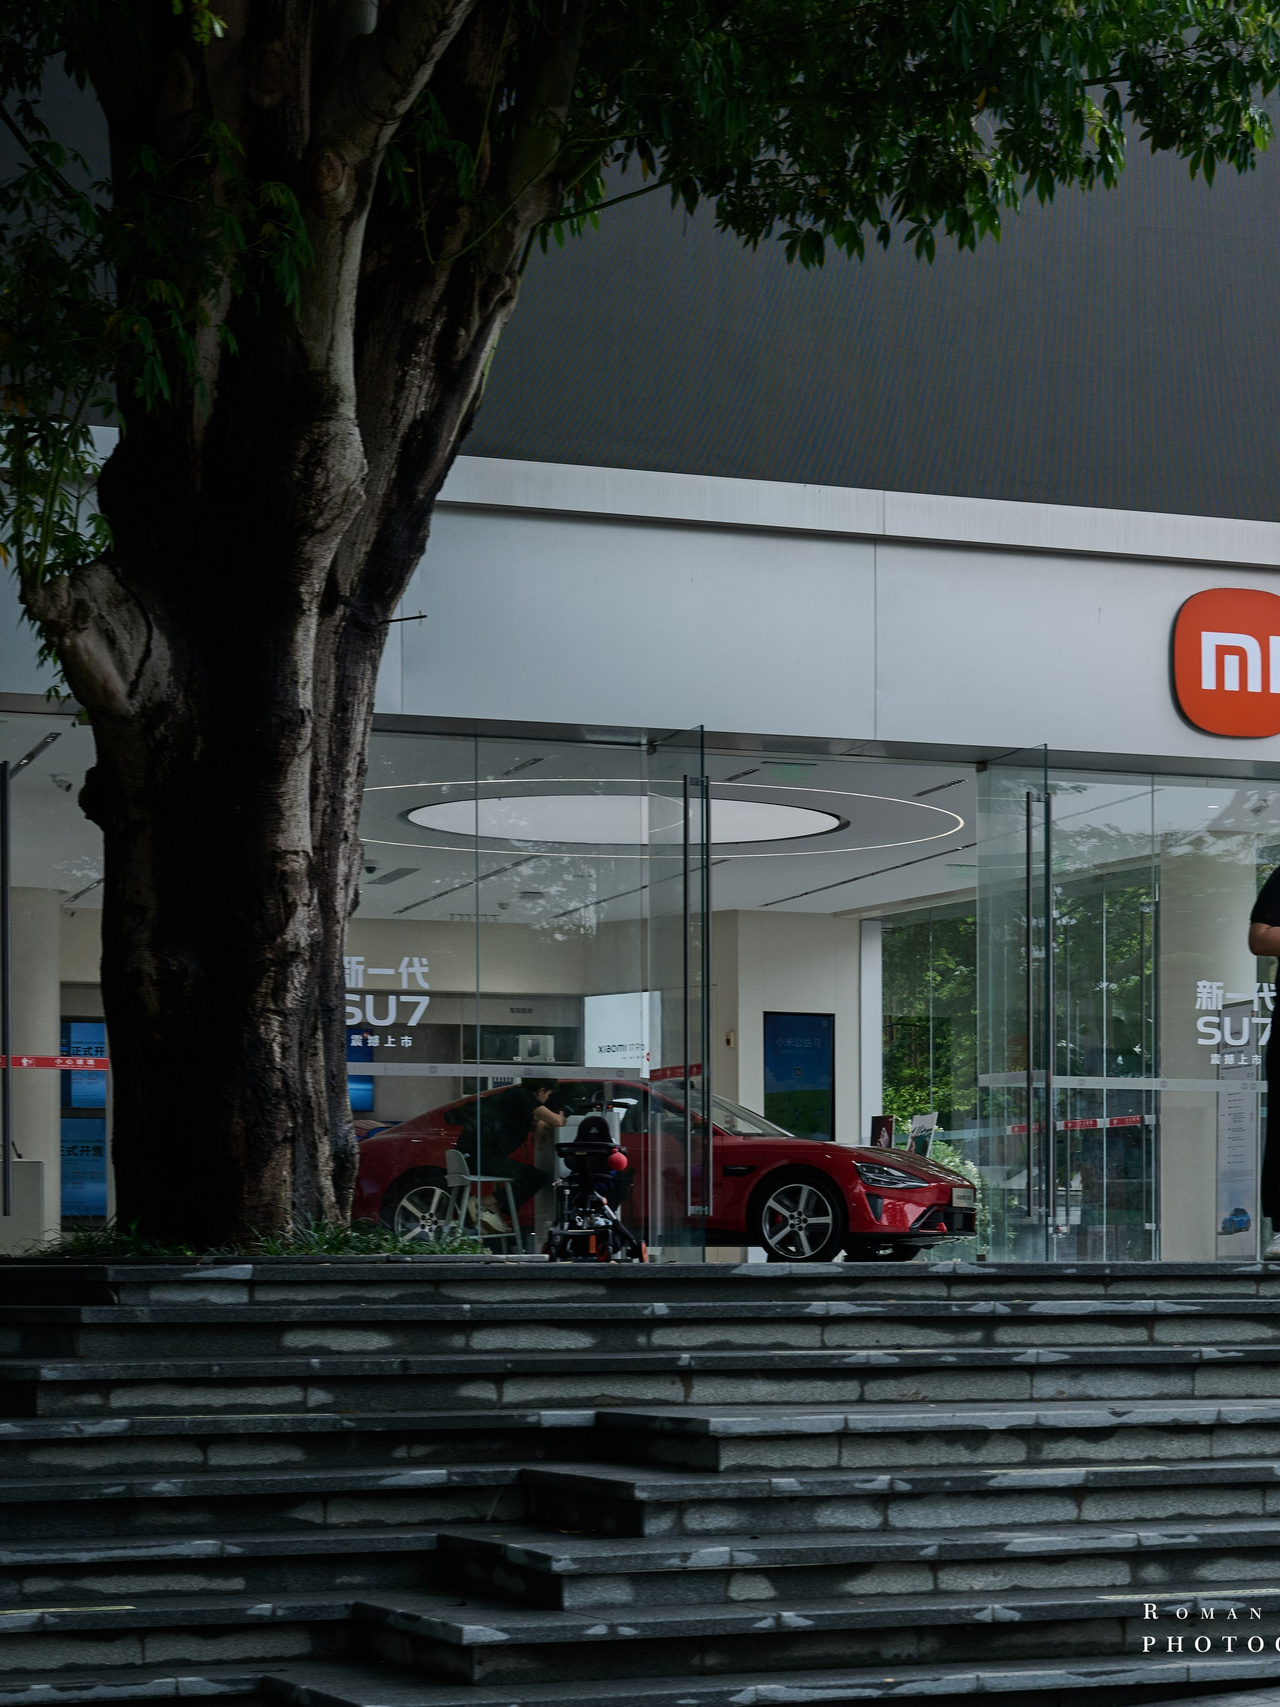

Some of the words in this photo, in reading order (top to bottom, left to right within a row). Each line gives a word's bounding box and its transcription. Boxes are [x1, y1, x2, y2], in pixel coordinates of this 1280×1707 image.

[343, 956, 430, 989] 新一代
[344, 993, 430, 1026] SU7
[1194, 980, 1277, 1011] 新一代
[350, 1034, 413, 1048] 震撼上市
[1196, 1016, 1272, 1046] SU7
[1210, 1053, 1262, 1066] 震撼上市
